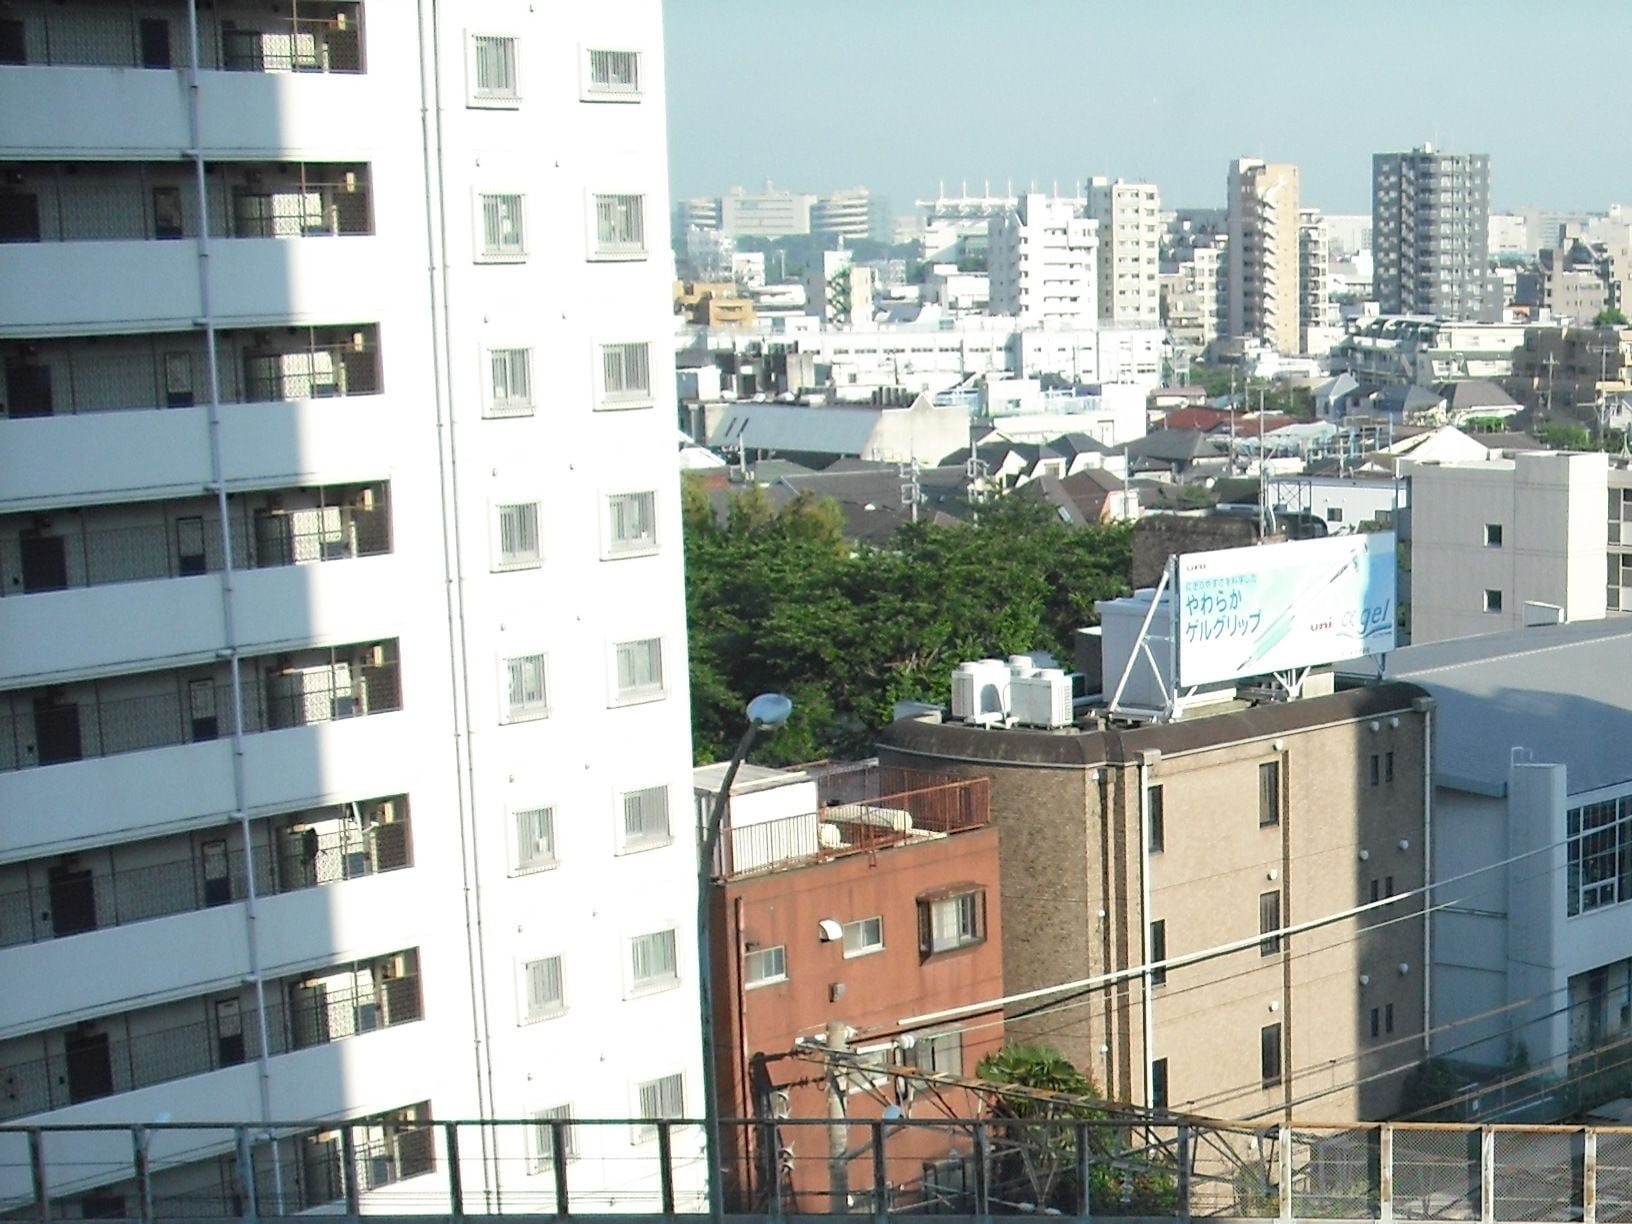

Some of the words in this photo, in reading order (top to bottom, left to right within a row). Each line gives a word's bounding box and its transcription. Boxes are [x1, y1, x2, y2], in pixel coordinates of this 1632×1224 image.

[1186, 588, 1242, 616] やわらか
[1186, 609, 1262, 643] ゲルグリップ
[1310, 616, 1333, 632] uni
